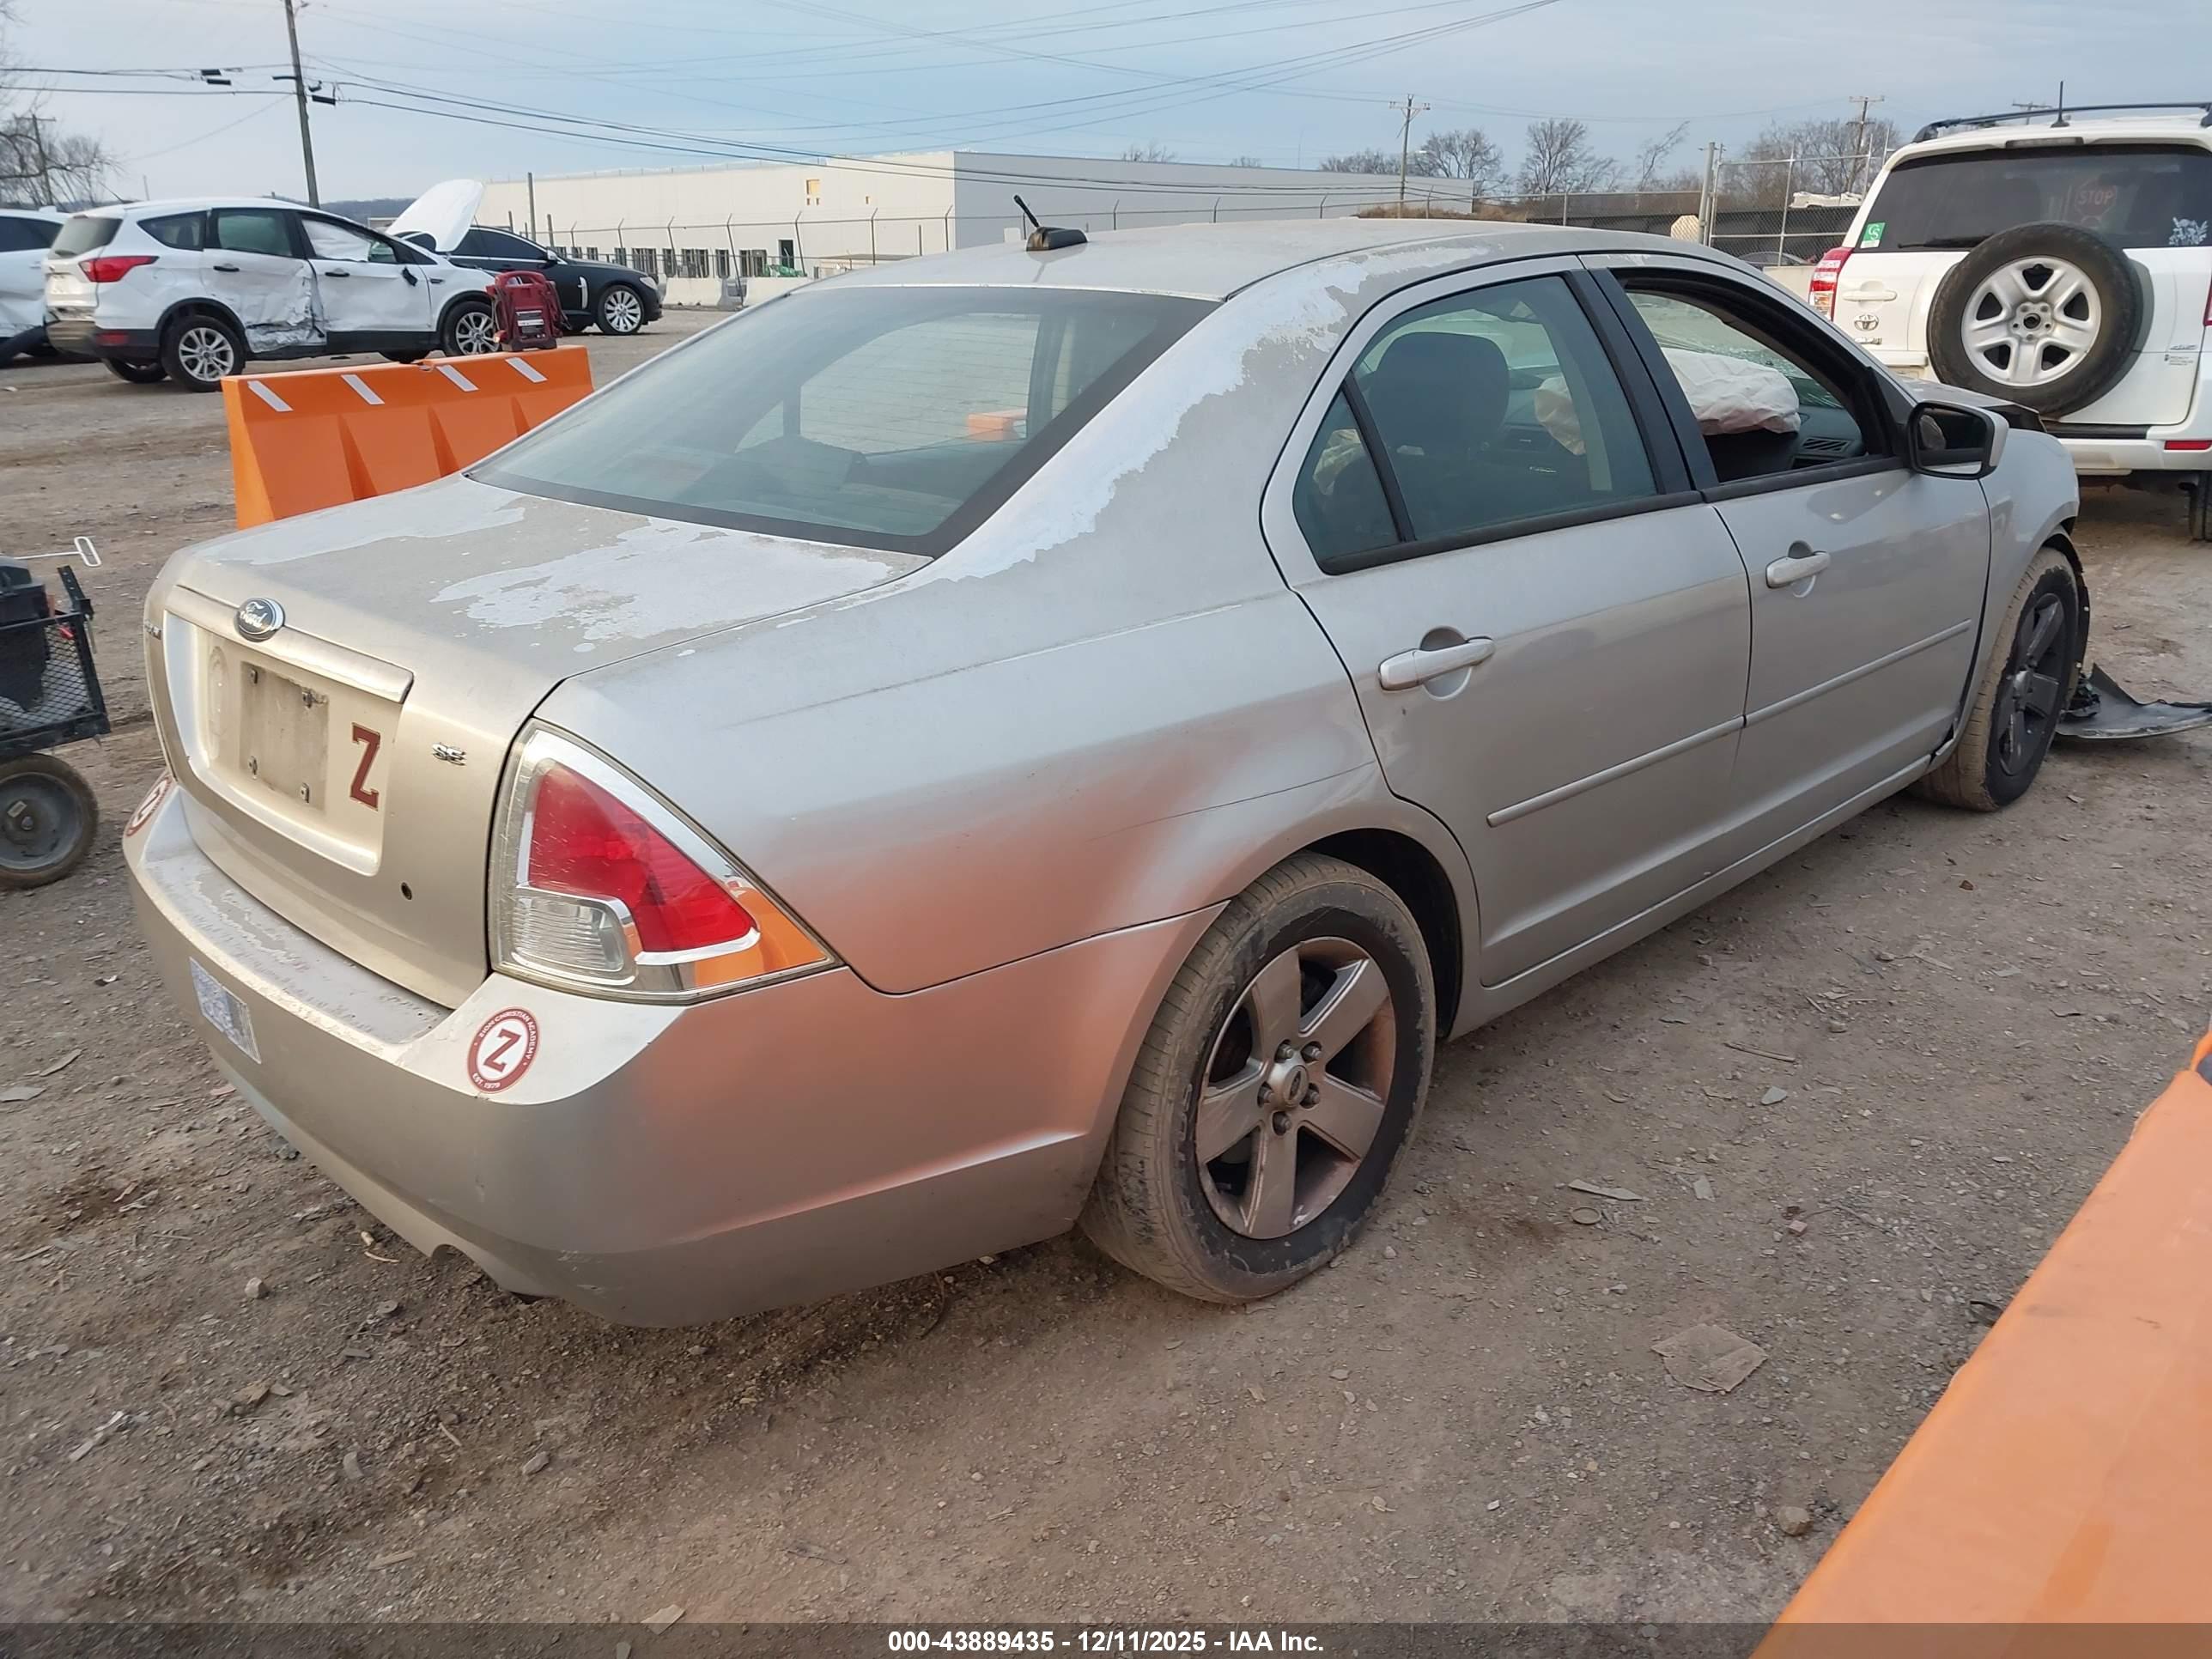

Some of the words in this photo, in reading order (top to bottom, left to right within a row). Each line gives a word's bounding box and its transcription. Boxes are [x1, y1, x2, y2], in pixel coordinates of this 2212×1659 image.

[2078, 190, 2114, 206] STOP
[240, 601, 268, 629] Ford
[349, 722, 380, 811] Z
[432, 742, 466, 766] SE
[483, 1028, 522, 1073] Z
[525, 1021, 537, 1060] ACADEMY
